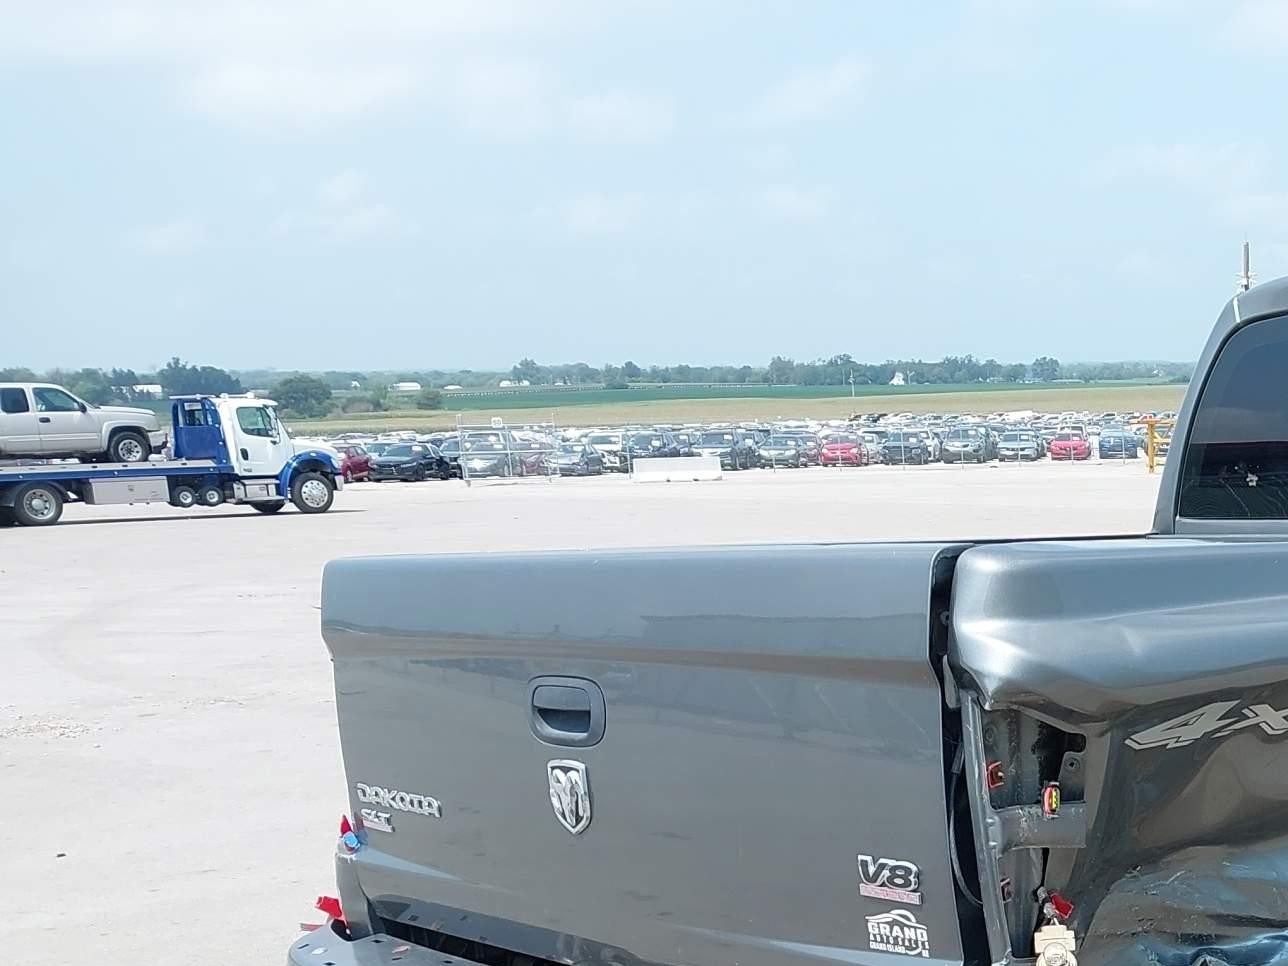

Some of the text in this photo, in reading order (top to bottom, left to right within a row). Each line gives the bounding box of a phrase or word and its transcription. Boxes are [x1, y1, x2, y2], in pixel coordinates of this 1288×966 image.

[357, 782, 441, 818] DAKOTA
[361, 808, 391, 826] SLT
[858, 854, 920, 892] V8
[867, 921, 928, 942] GRAND
[869, 933, 929, 949] AUTO SALES
